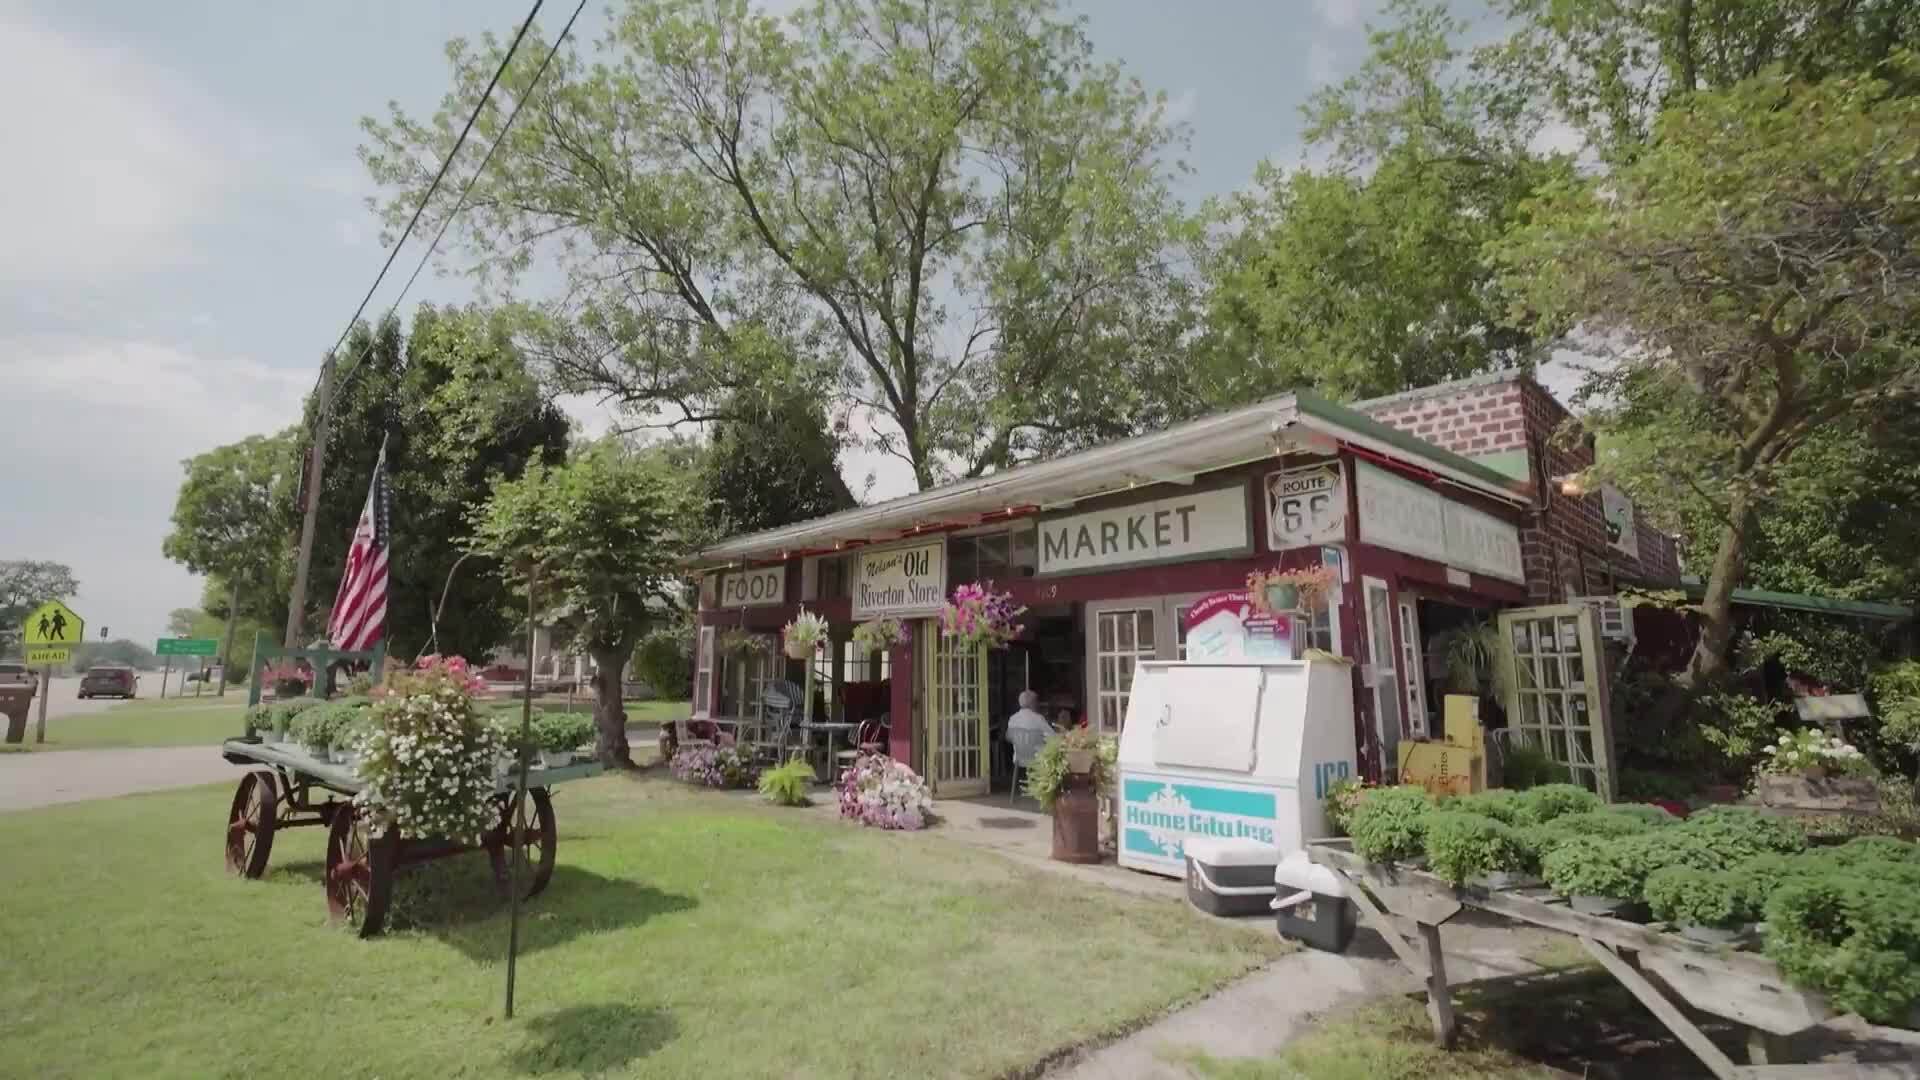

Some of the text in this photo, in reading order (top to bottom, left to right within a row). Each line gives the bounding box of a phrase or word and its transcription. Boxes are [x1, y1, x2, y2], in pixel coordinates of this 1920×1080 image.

[1283, 479, 1326, 493] ROUTE
[1044, 504, 1196, 563] MARKET
[904, 550, 929, 577] Old
[726, 574, 778, 602] FOOD
[861, 578, 938, 609] Riverton Store
[31, 651, 66, 661] AHEAD
[1127, 805, 1273, 844] Home City Ice
